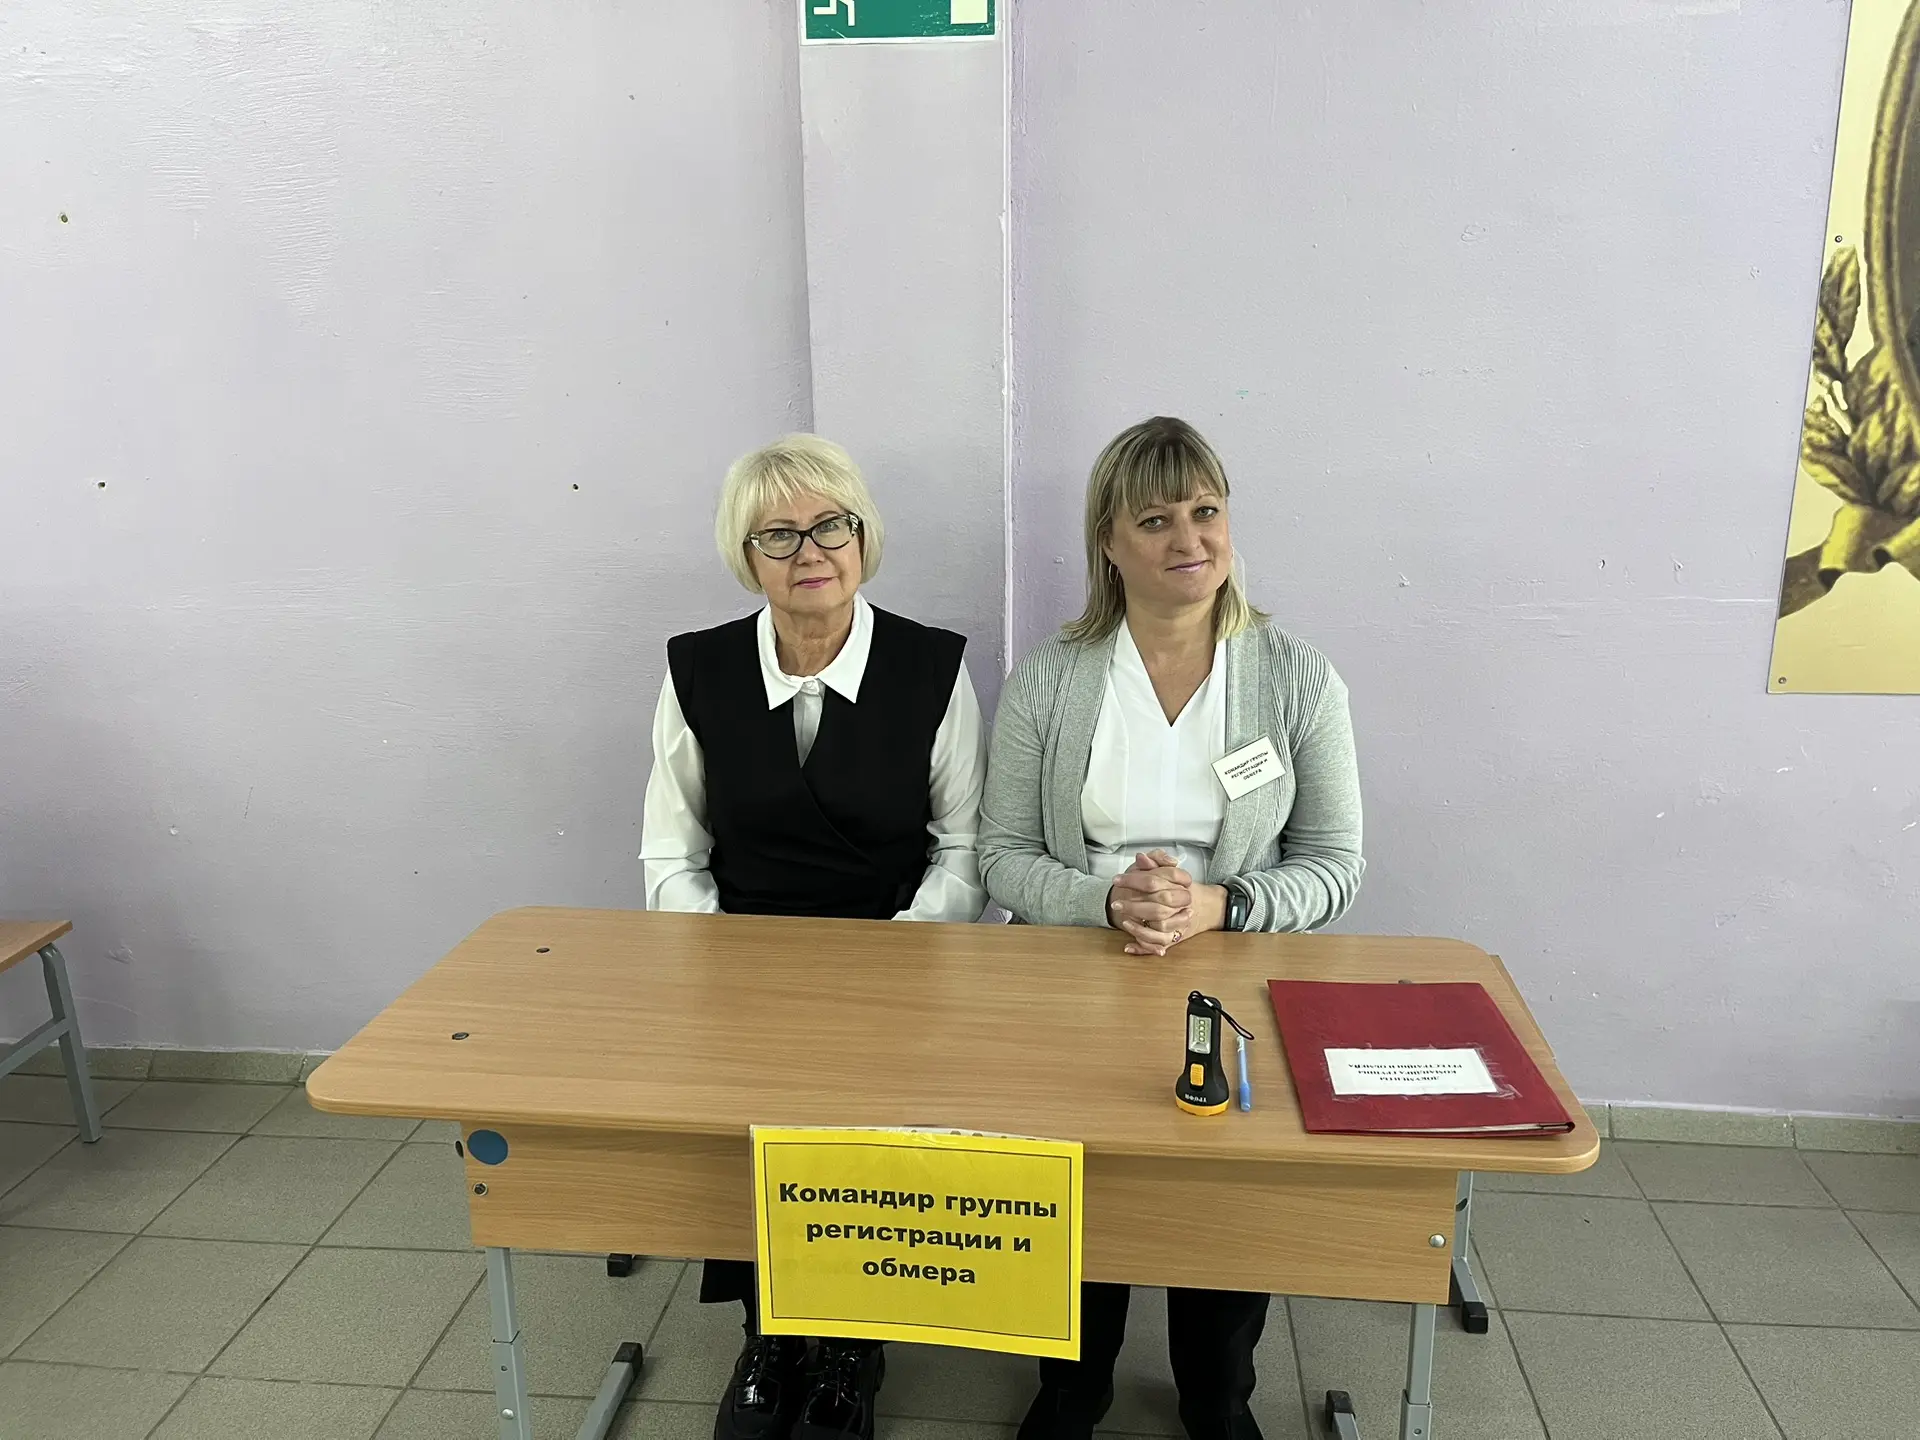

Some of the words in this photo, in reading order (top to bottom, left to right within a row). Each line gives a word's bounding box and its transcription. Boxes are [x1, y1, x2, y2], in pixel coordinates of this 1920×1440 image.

[1224, 760, 1250, 775] КОМАНДИР
[1250, 751, 1268, 762] ГРУППЫ
[1231, 760, 1263, 778] РЕГИСТРАЦИИ
[1243, 768, 1262, 780] ОБМЕРА
[779, 1182, 935, 1213] Командир
[945, 1193, 1058, 1219] группы
[806, 1222, 1002, 1252] регистрации
[1013, 1236, 1031, 1252] и
[862, 1257, 976, 1286] обмера
